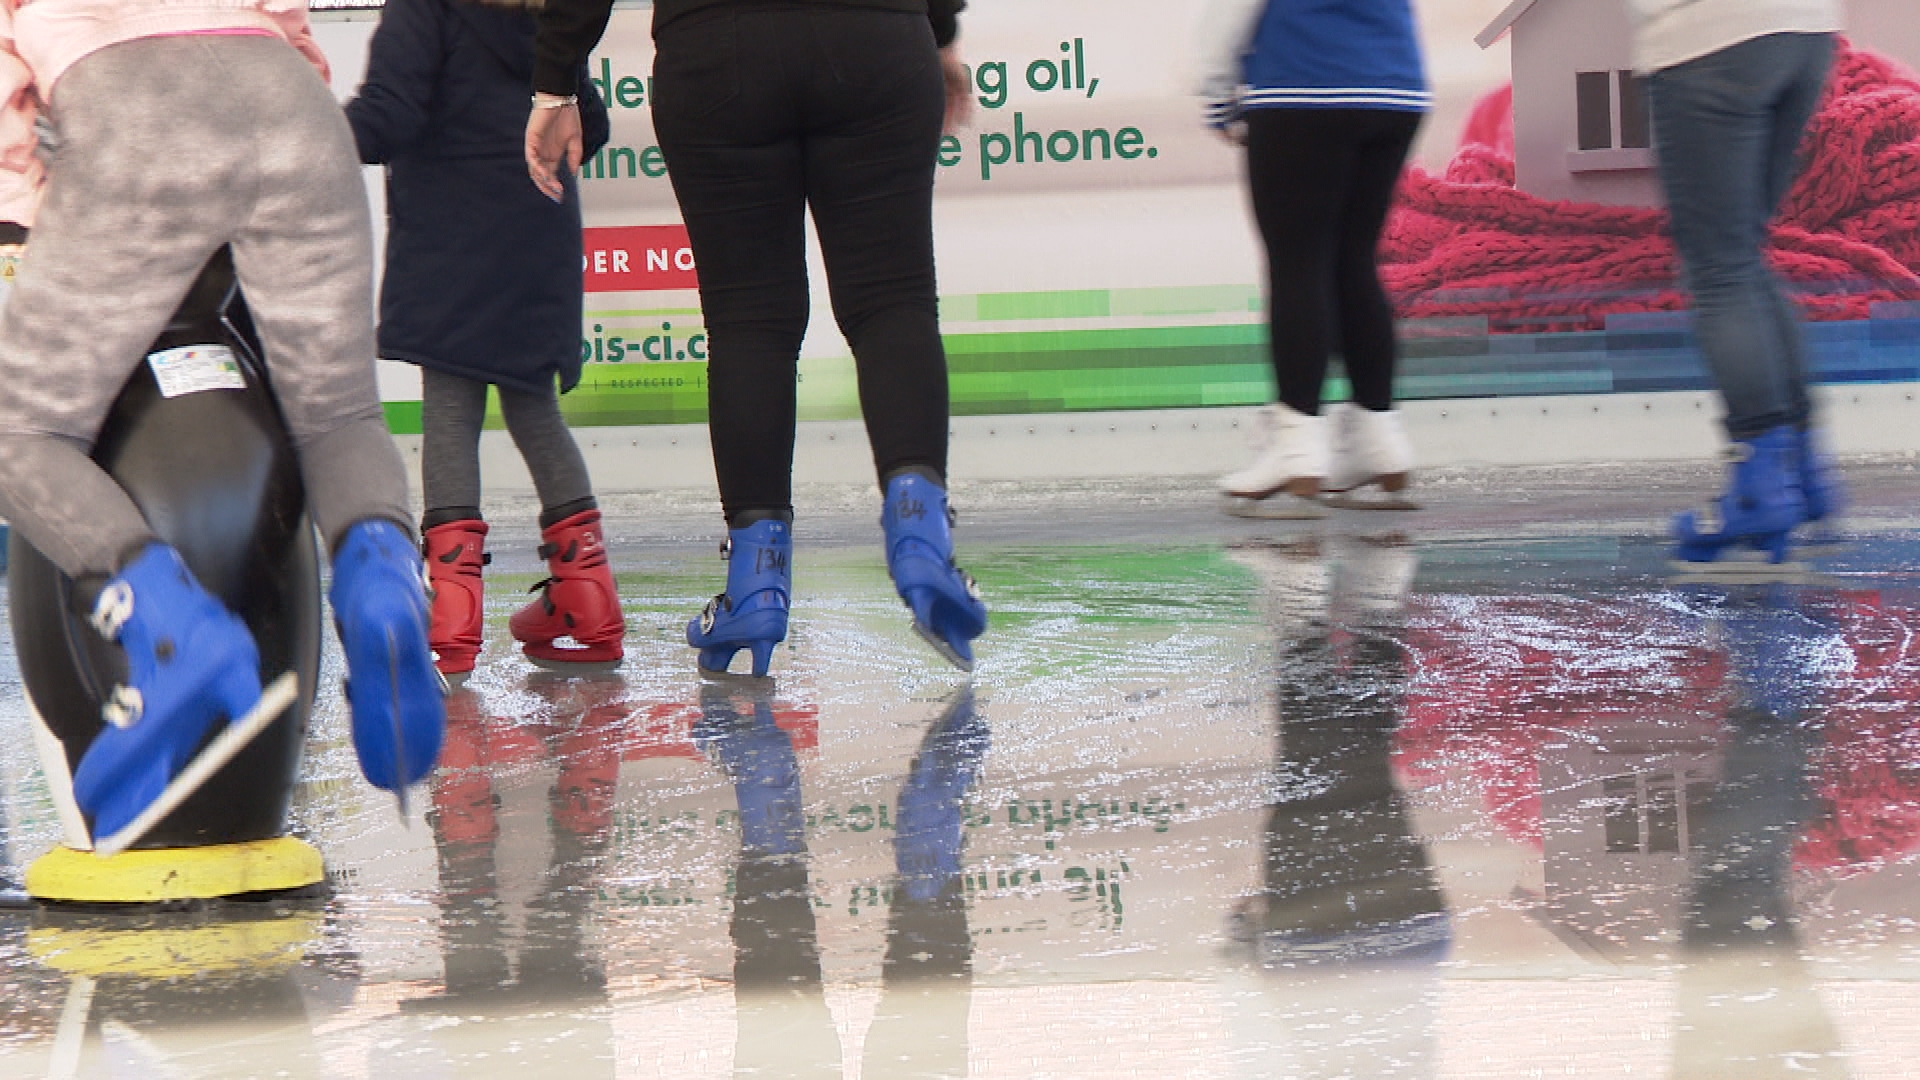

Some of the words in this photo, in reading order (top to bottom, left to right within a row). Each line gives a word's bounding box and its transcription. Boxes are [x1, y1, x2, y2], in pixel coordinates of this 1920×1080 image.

[1025, 37, 1100, 99] oil,
[979, 111, 1158, 181] phone.
[582, 249, 631, 274] ER
[611, 377, 684, 389] RESPECTED
[756, 546, 787, 576] 134
